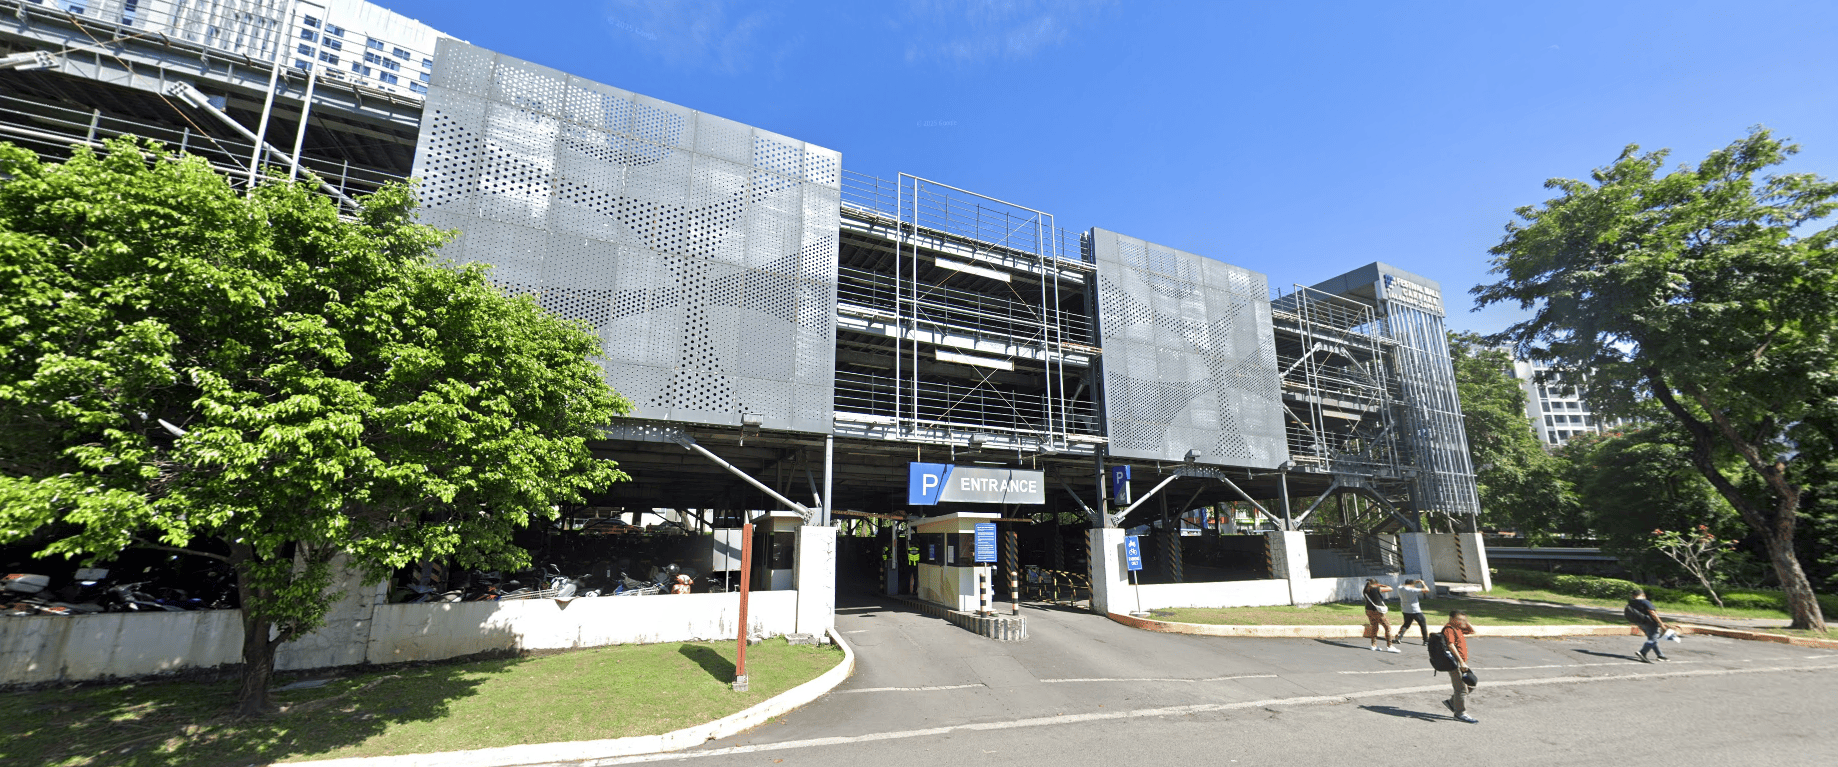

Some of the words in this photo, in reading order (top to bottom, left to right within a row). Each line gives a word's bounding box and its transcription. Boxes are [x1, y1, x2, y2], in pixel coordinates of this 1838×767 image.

[1396, 276, 1424, 294] FESTIVAL
[1424, 286, 1440, 299] MALL
[922, 473, 939, 496] P
[960, 477, 1037, 493] ENTRANCE
[1115, 471, 1124, 485] P
